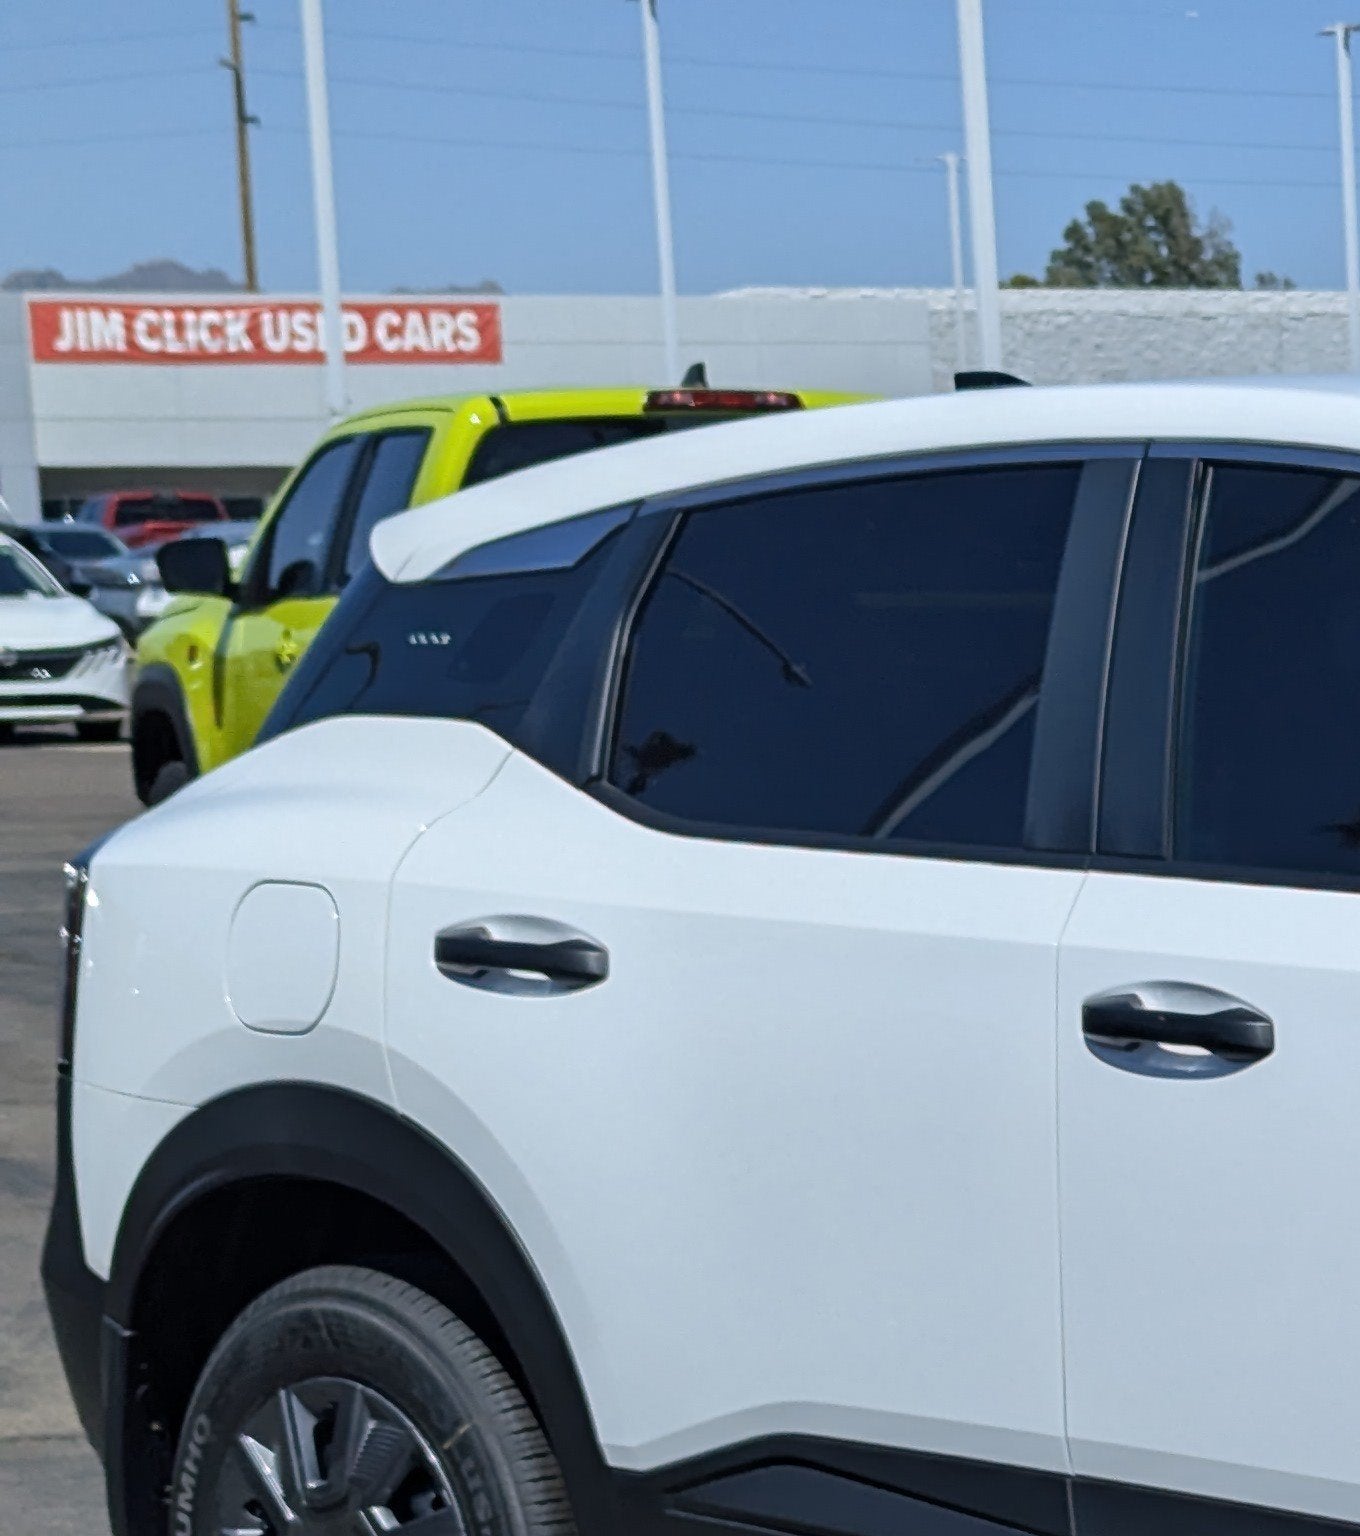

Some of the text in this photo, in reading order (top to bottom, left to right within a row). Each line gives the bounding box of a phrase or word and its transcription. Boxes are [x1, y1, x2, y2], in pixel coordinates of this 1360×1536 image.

[54, 309, 127, 353] JIM
[133, 309, 254, 354] CLICK
[375, 310, 482, 353] CARS
